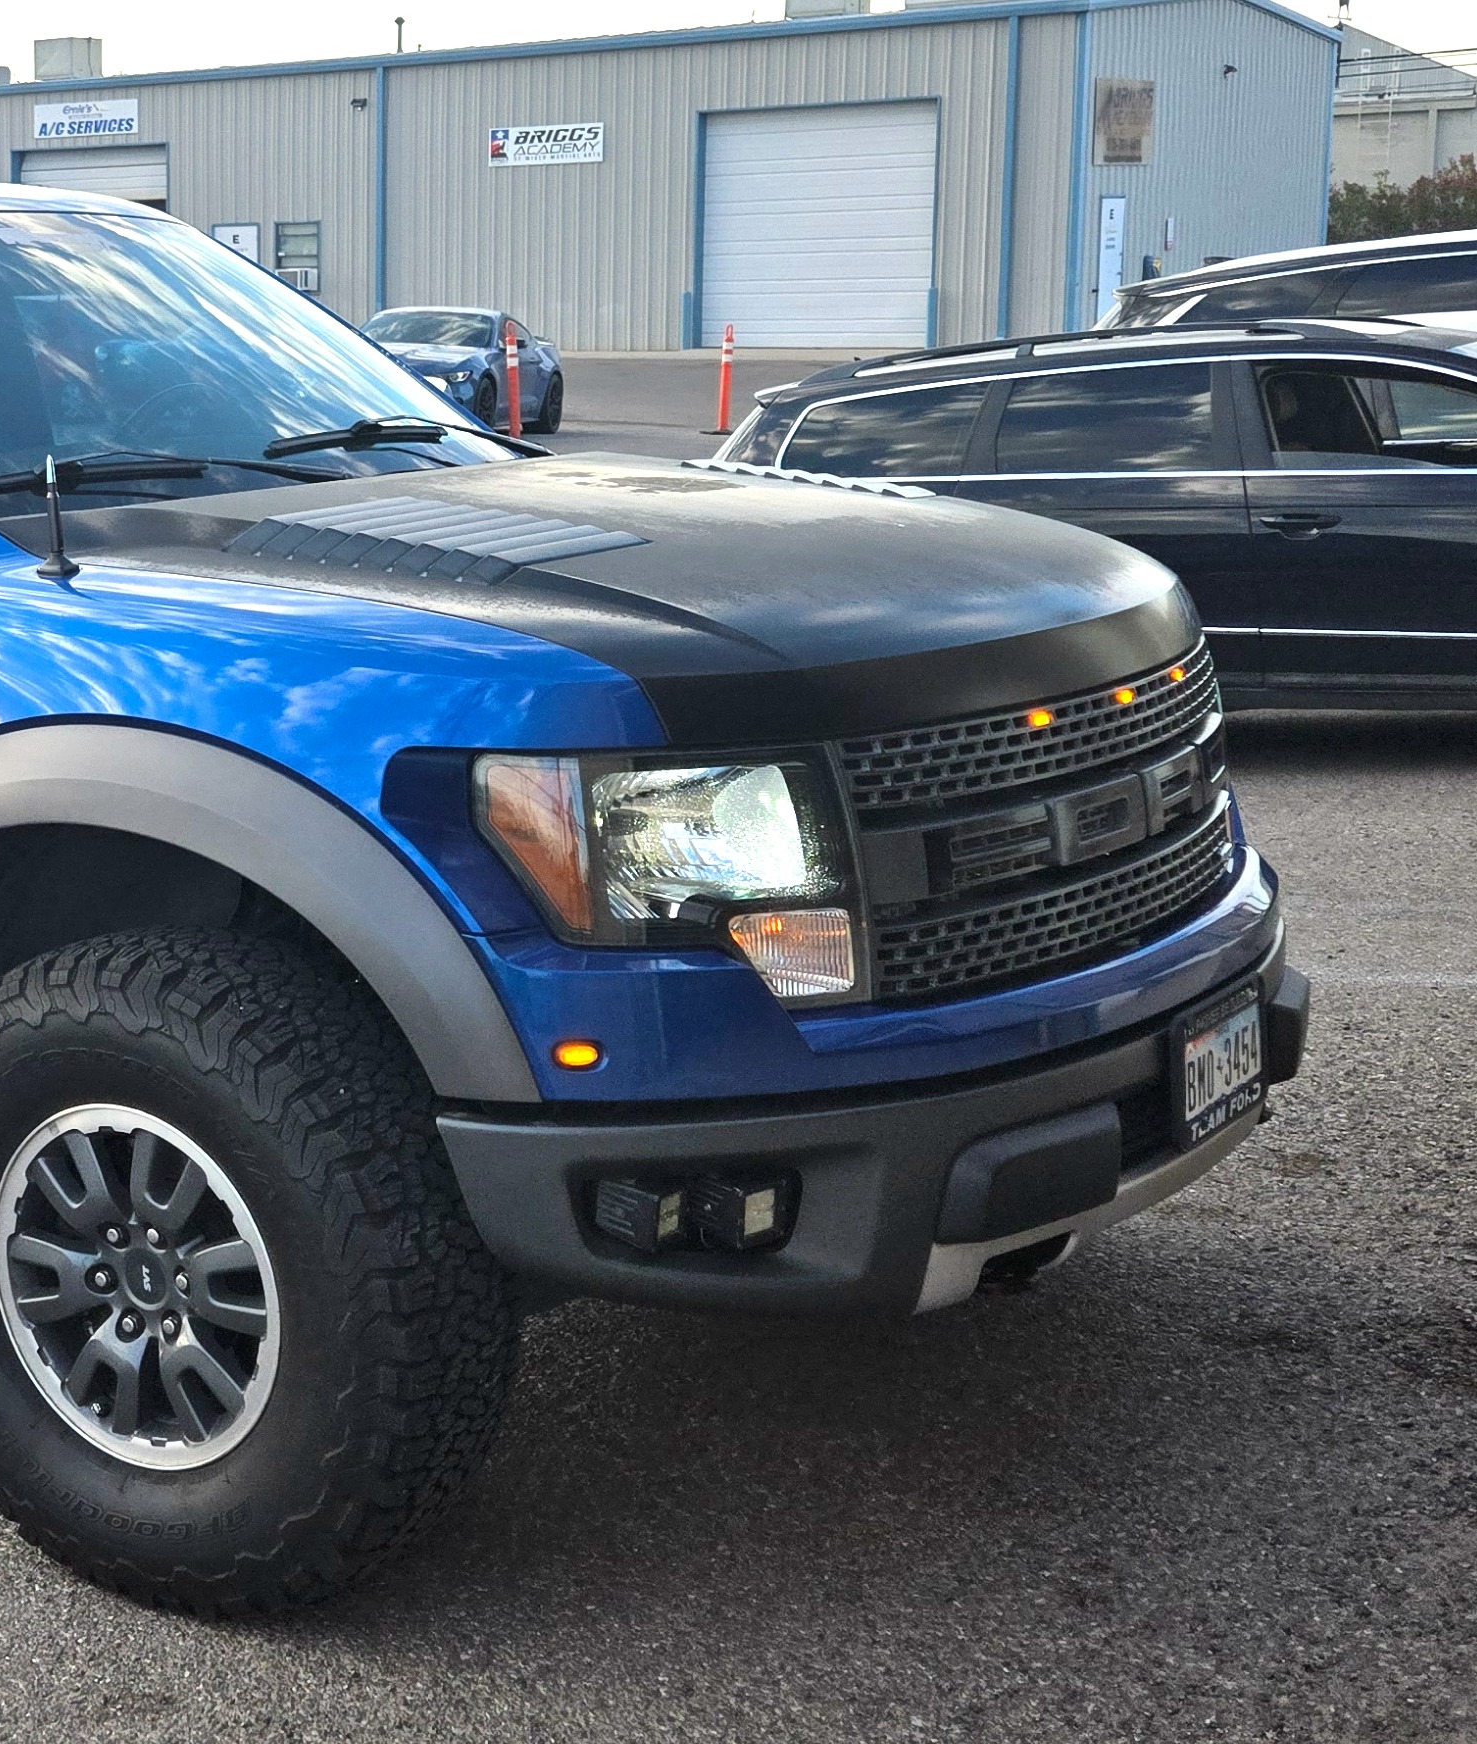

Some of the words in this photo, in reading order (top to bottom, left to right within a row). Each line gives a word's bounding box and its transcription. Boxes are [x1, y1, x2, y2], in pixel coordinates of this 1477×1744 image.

[39, 121, 65, 137] A/C
[67, 118, 135, 134] SERVICES
[514, 127, 601, 145] BRIGGS
[514, 141, 601, 156] ACADEMY
[1109, 208, 1115, 220] E
[232, 234, 240, 245] E
[142, 1264, 152, 1293] SVT
